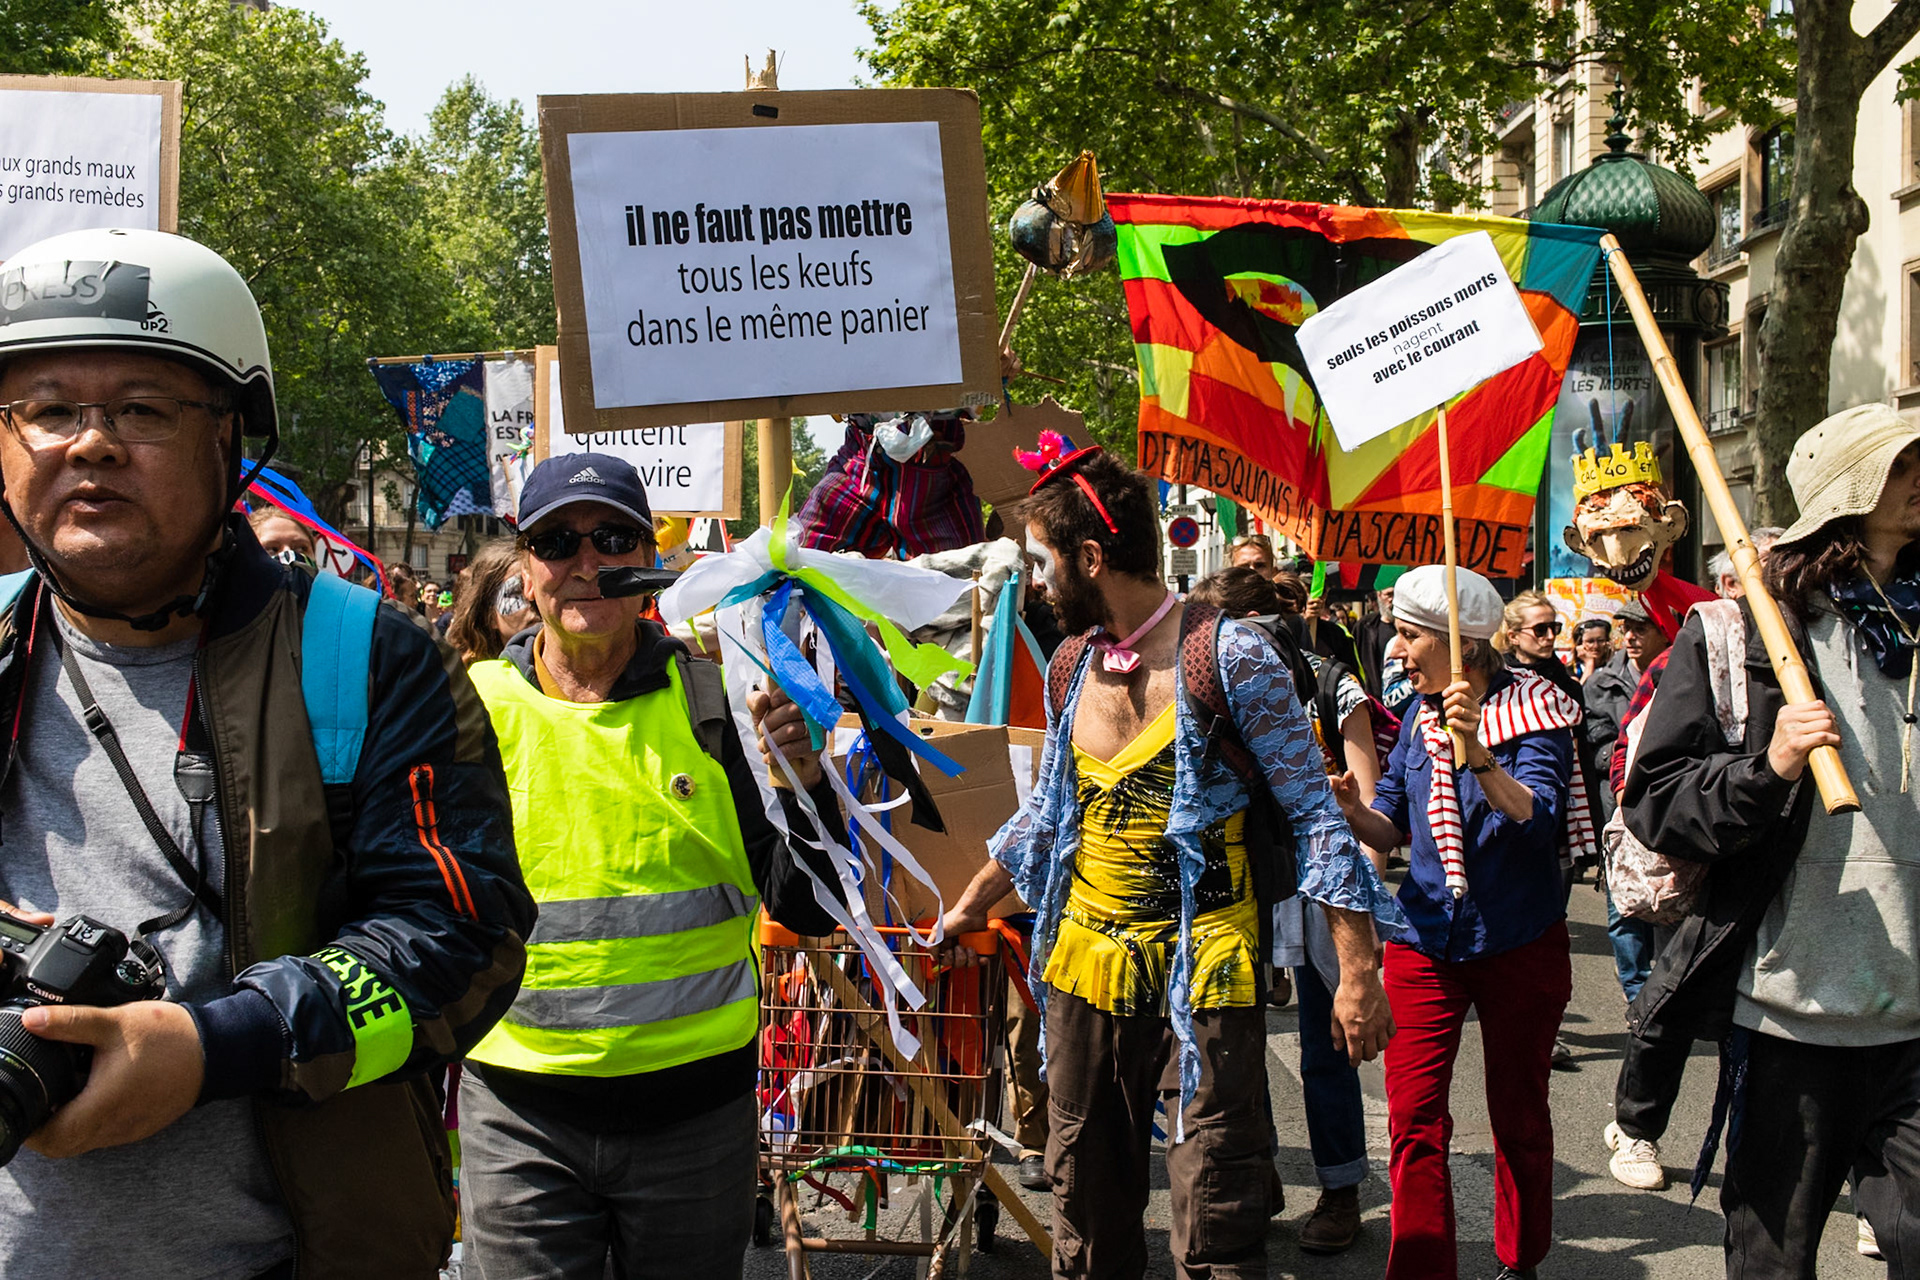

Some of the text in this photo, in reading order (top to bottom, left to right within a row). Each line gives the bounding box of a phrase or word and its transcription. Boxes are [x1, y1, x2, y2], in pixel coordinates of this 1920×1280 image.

[0, 155, 136, 179] ux grands maux
[8, 182, 64, 204] grands
[69, 186, 144, 208] remèdes
[625, 199, 912, 246] il ne faut pas mettre
[678, 250, 873, 294] tous les keufs
[627, 299, 930, 346] dans le même panier
[1327, 272, 1498, 370] seuls les poissons morts
[1372, 319, 1481, 384] avec le courant
[1392, 321, 1444, 356] nagent
[1571, 377, 1651, 393] LES MORTS
[492, 410, 512, 422] LA
[569, 475, 606, 486] adidas
[635, 458, 692, 487] vire
[1581, 470, 1596, 484] CAC
[1604, 464, 1627, 477] 40
[1143, 431, 1292, 526] DEMASQUONS
[1295, 496, 1314, 550] LA
[27, 982, 64, 1003] Canon
